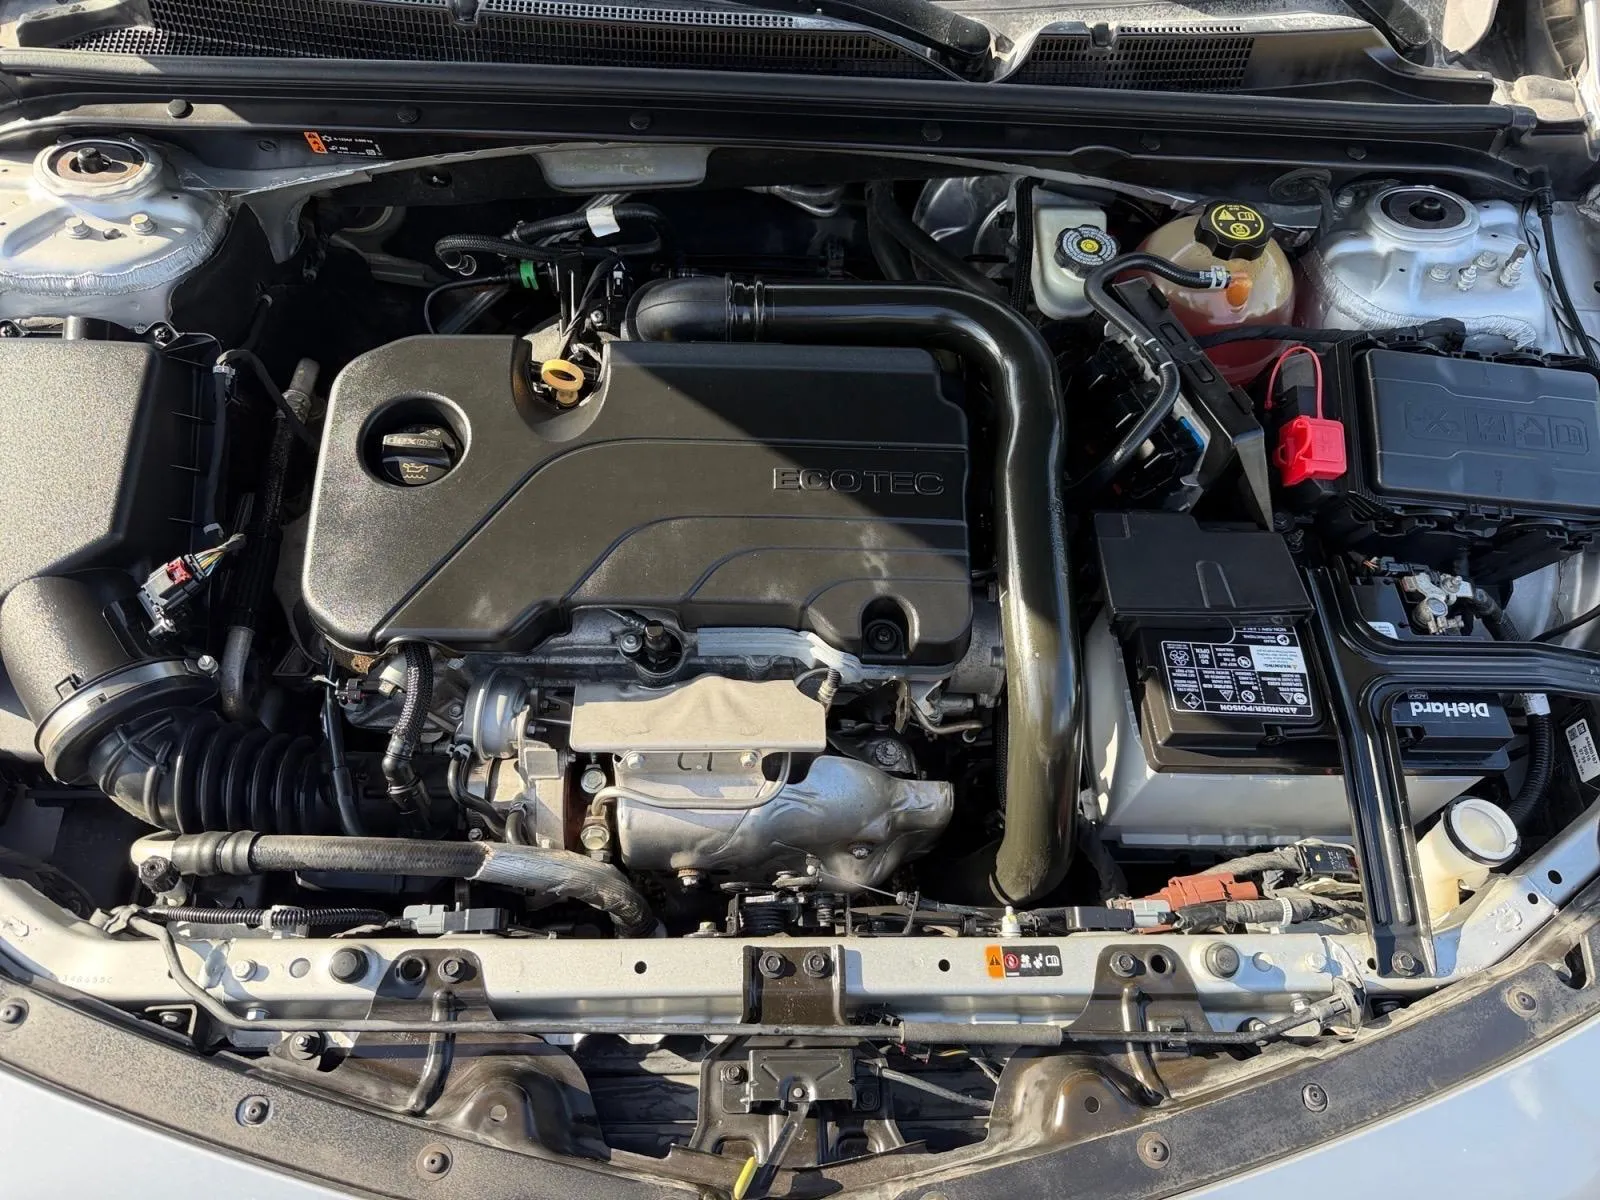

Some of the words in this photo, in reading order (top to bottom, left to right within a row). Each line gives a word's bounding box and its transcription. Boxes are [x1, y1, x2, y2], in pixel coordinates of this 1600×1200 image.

[773, 467, 945, 496] ECOTEC
[1220, 704, 1290, 714] DANGER/POISON
[1409, 702, 1490, 718] DieHard
